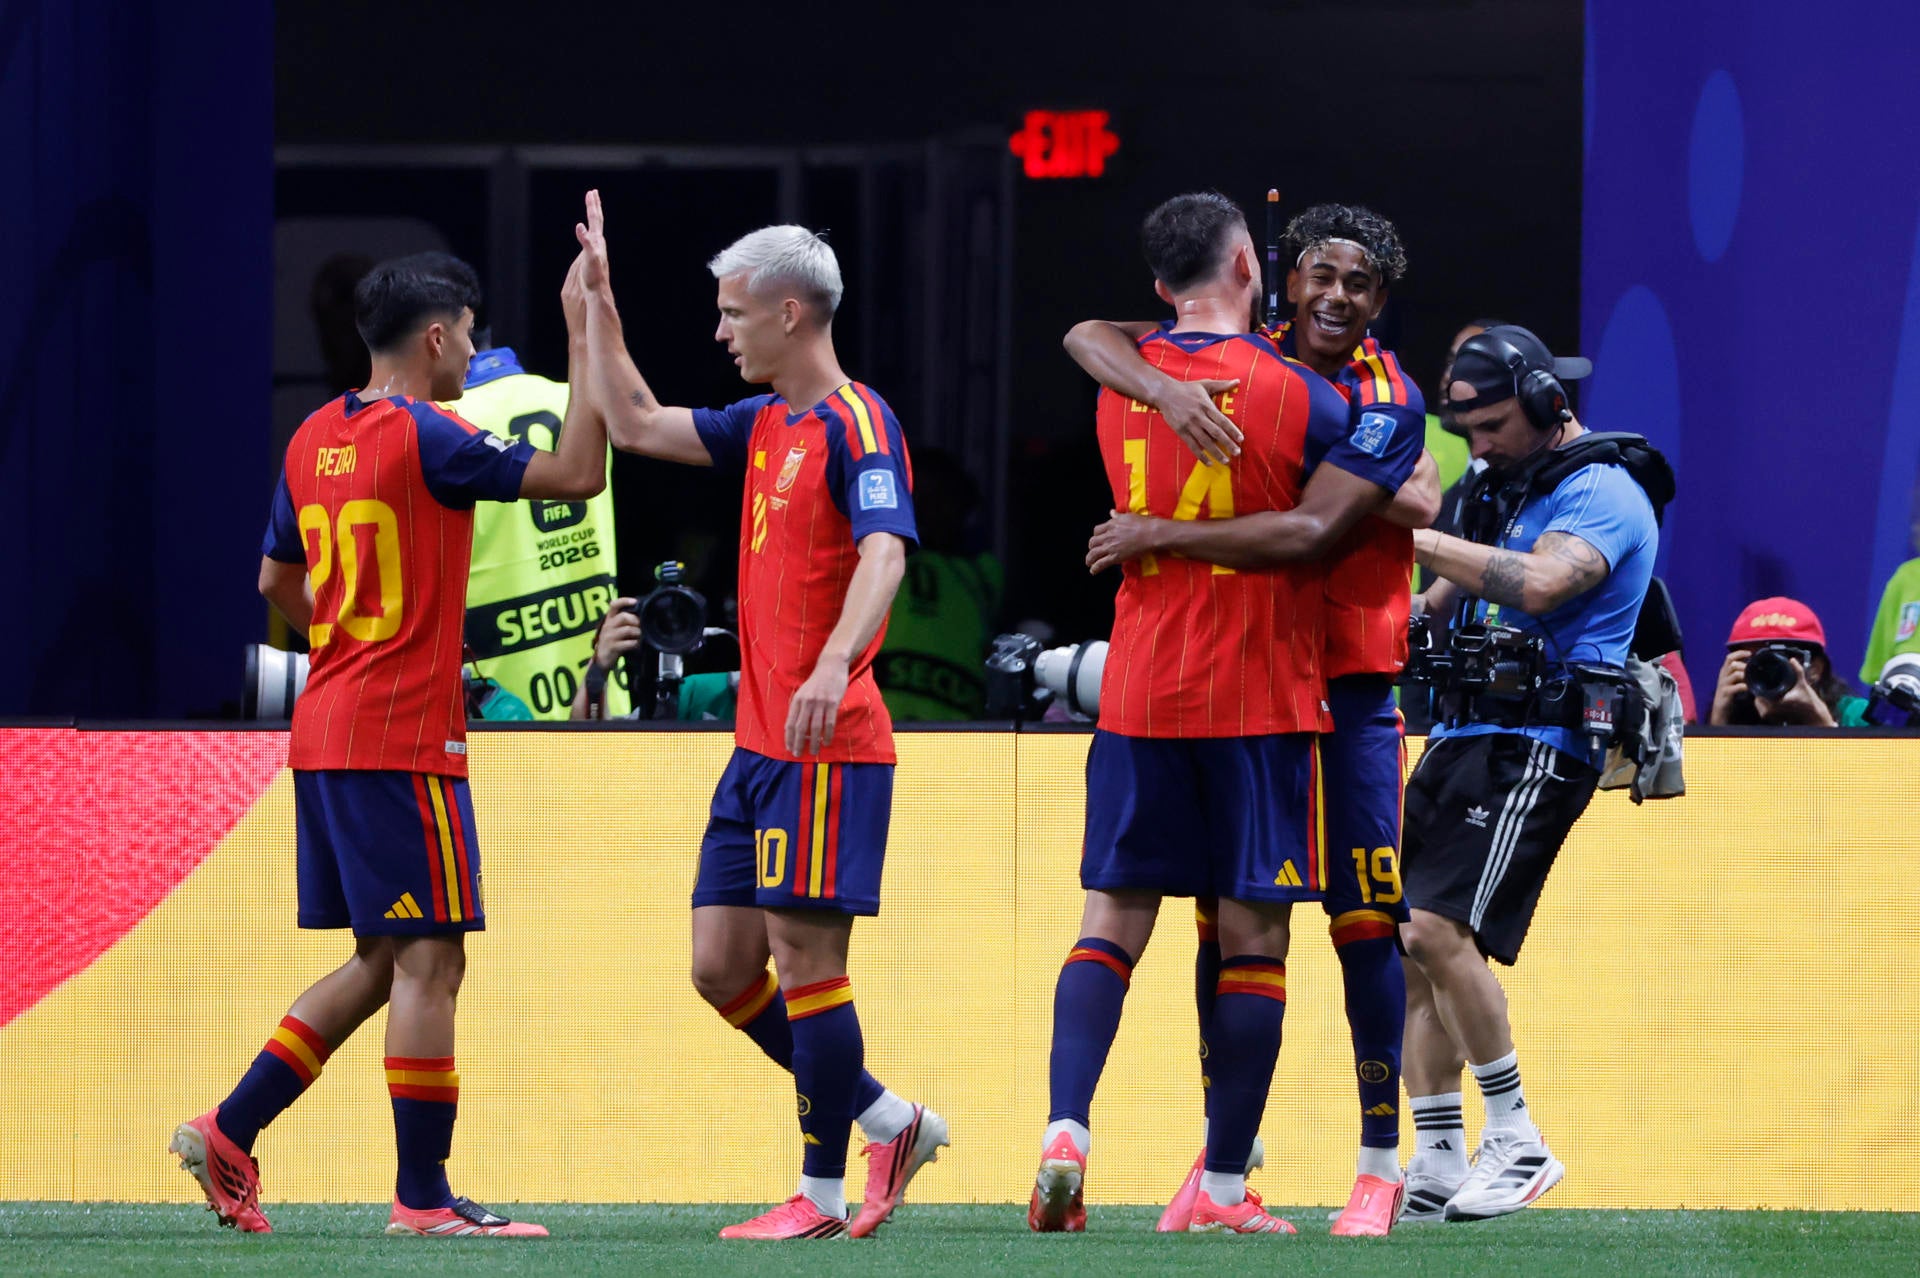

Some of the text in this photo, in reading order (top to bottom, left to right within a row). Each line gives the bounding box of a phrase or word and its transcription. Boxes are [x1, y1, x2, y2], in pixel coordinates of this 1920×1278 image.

[1024, 110, 1109, 178] EXIT
[315, 444, 357, 477] PEDRI
[541, 503, 572, 524] FIFA
[536, 527, 596, 551] WORLD CUP
[539, 541, 600, 571] 2026
[298, 499, 404, 649] 20
[1351, 846, 1403, 904] 19
